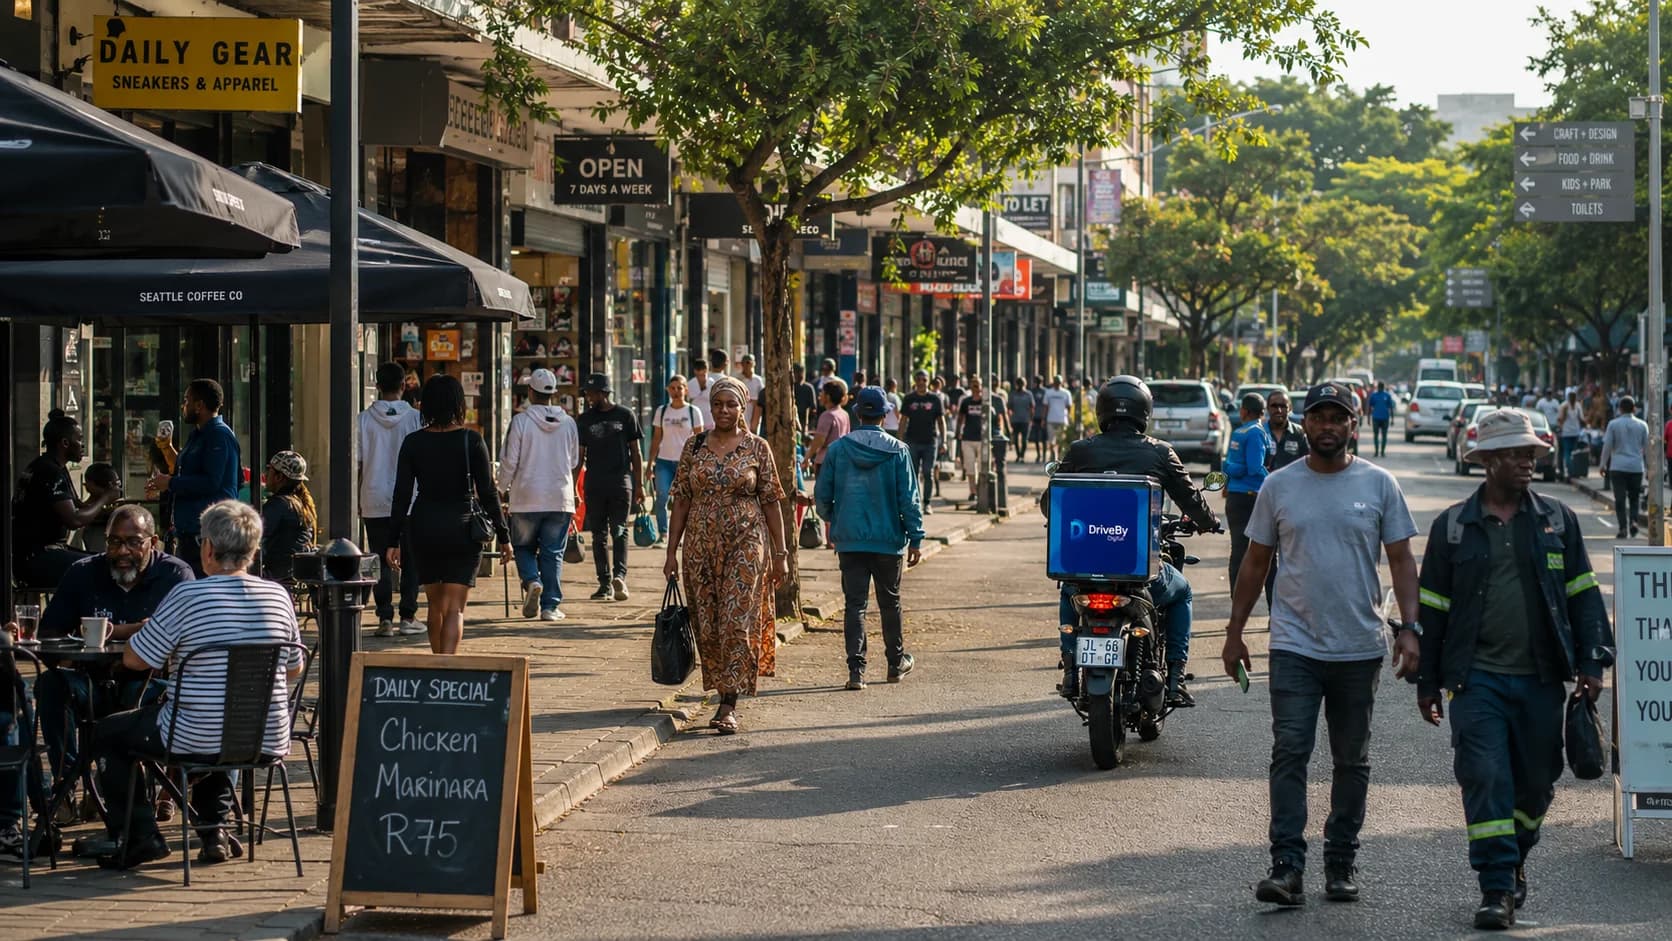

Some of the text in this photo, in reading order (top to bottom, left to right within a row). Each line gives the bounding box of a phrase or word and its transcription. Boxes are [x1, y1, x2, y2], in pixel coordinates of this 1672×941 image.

[100, 39, 293, 66] DAILY GEAR
[112, 75, 278, 91] SNEAKERS & APPAREL
[1553, 128, 1578, 140] CRAFT
[1588, 128, 1617, 140] DESIGN
[1558, 152, 1580, 165] FOOD
[1589, 152, 1615, 165] DRINK
[579, 158, 643, 178] OPEN
[570, 184, 653, 195] 7 DAYS A WEEK
[1562, 178, 1580, 190] KIDS
[1590, 178, 1612, 190] PARK
[1003, 196, 1049, 212] TO LET
[1571, 203, 1603, 215] TOILETS
[140, 290, 243, 302] SEATTLE COFFEE CO
[1088, 524, 1128, 537] DriveBy
[1634, 571, 1672, 598] TH
[1083, 639, 1096, 652] JL
[1081, 652, 1118, 665] DT GP
[374, 677, 494, 701] DAILY SPECIAL
[380, 716, 477, 754] Chicken
[379, 812, 461, 858] R75
